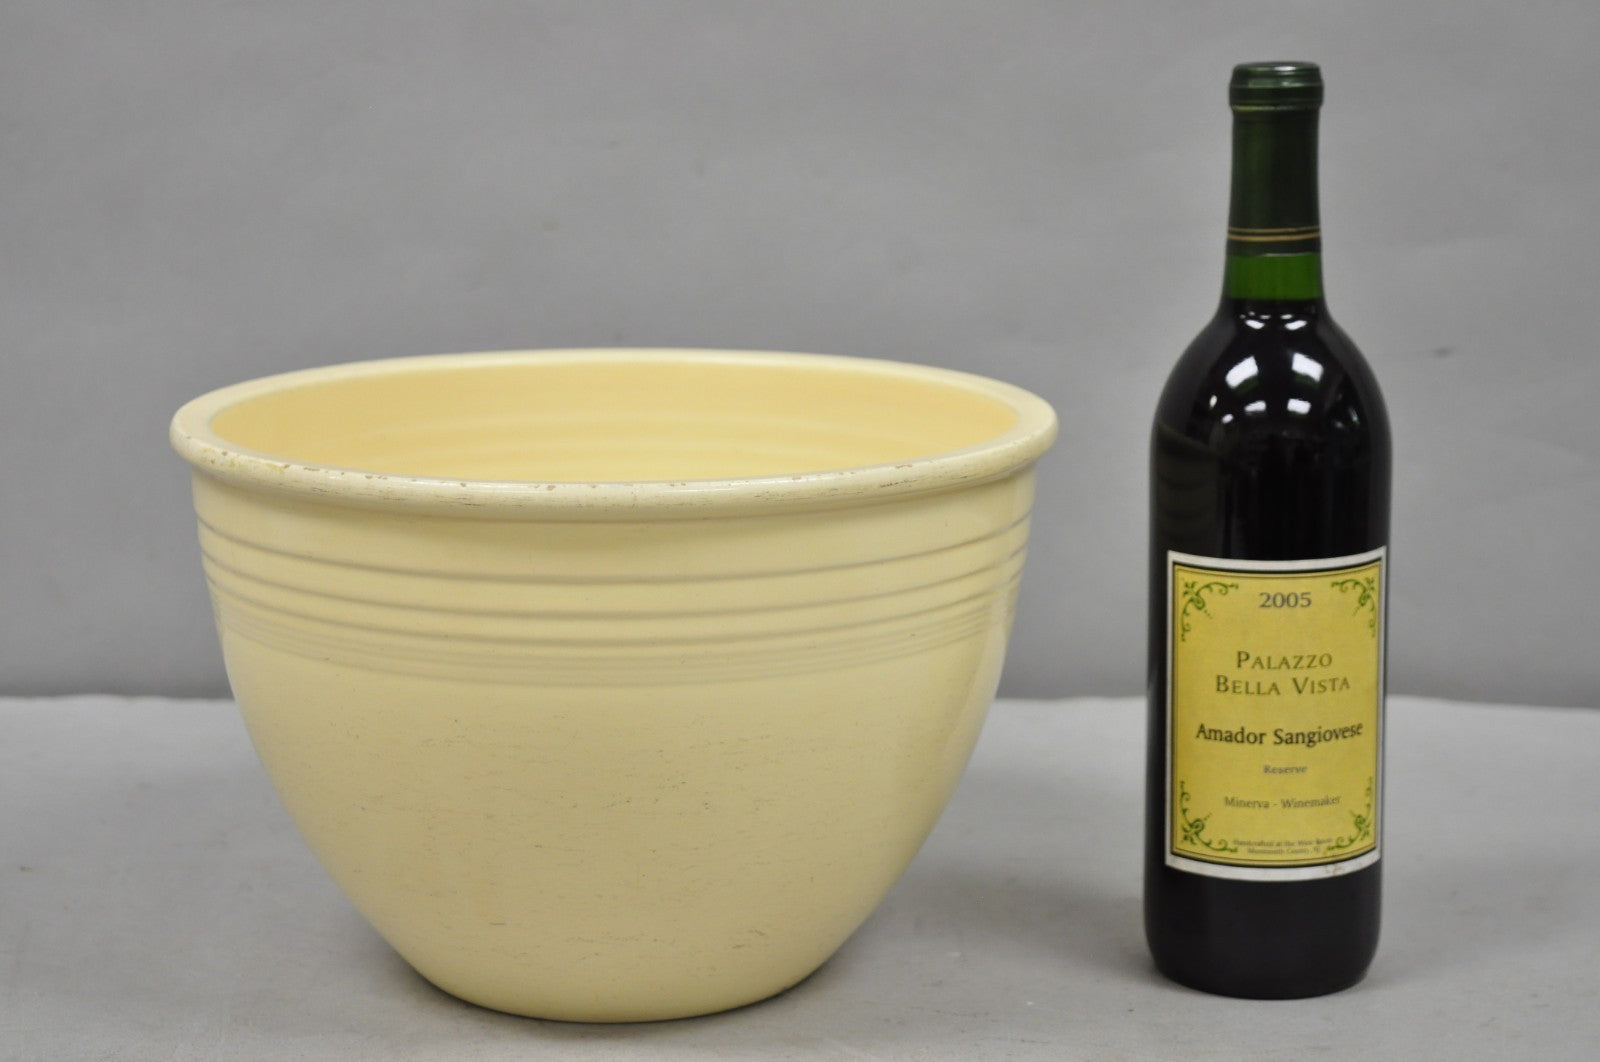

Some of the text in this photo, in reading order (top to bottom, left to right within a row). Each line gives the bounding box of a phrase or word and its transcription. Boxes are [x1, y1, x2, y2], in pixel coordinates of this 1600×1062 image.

[1259, 592, 1312, 608] 2005
[1236, 651, 1333, 669] PALAZZO
[1216, 675, 1350, 695] BELLA VISTA
[1196, 723, 1363, 747] Amador Sangiovese
[1263, 765, 1308, 774] Reserve
[1224, 796, 1270, 808] Minerva
[1281, 796, 1341, 808] Winemaker
